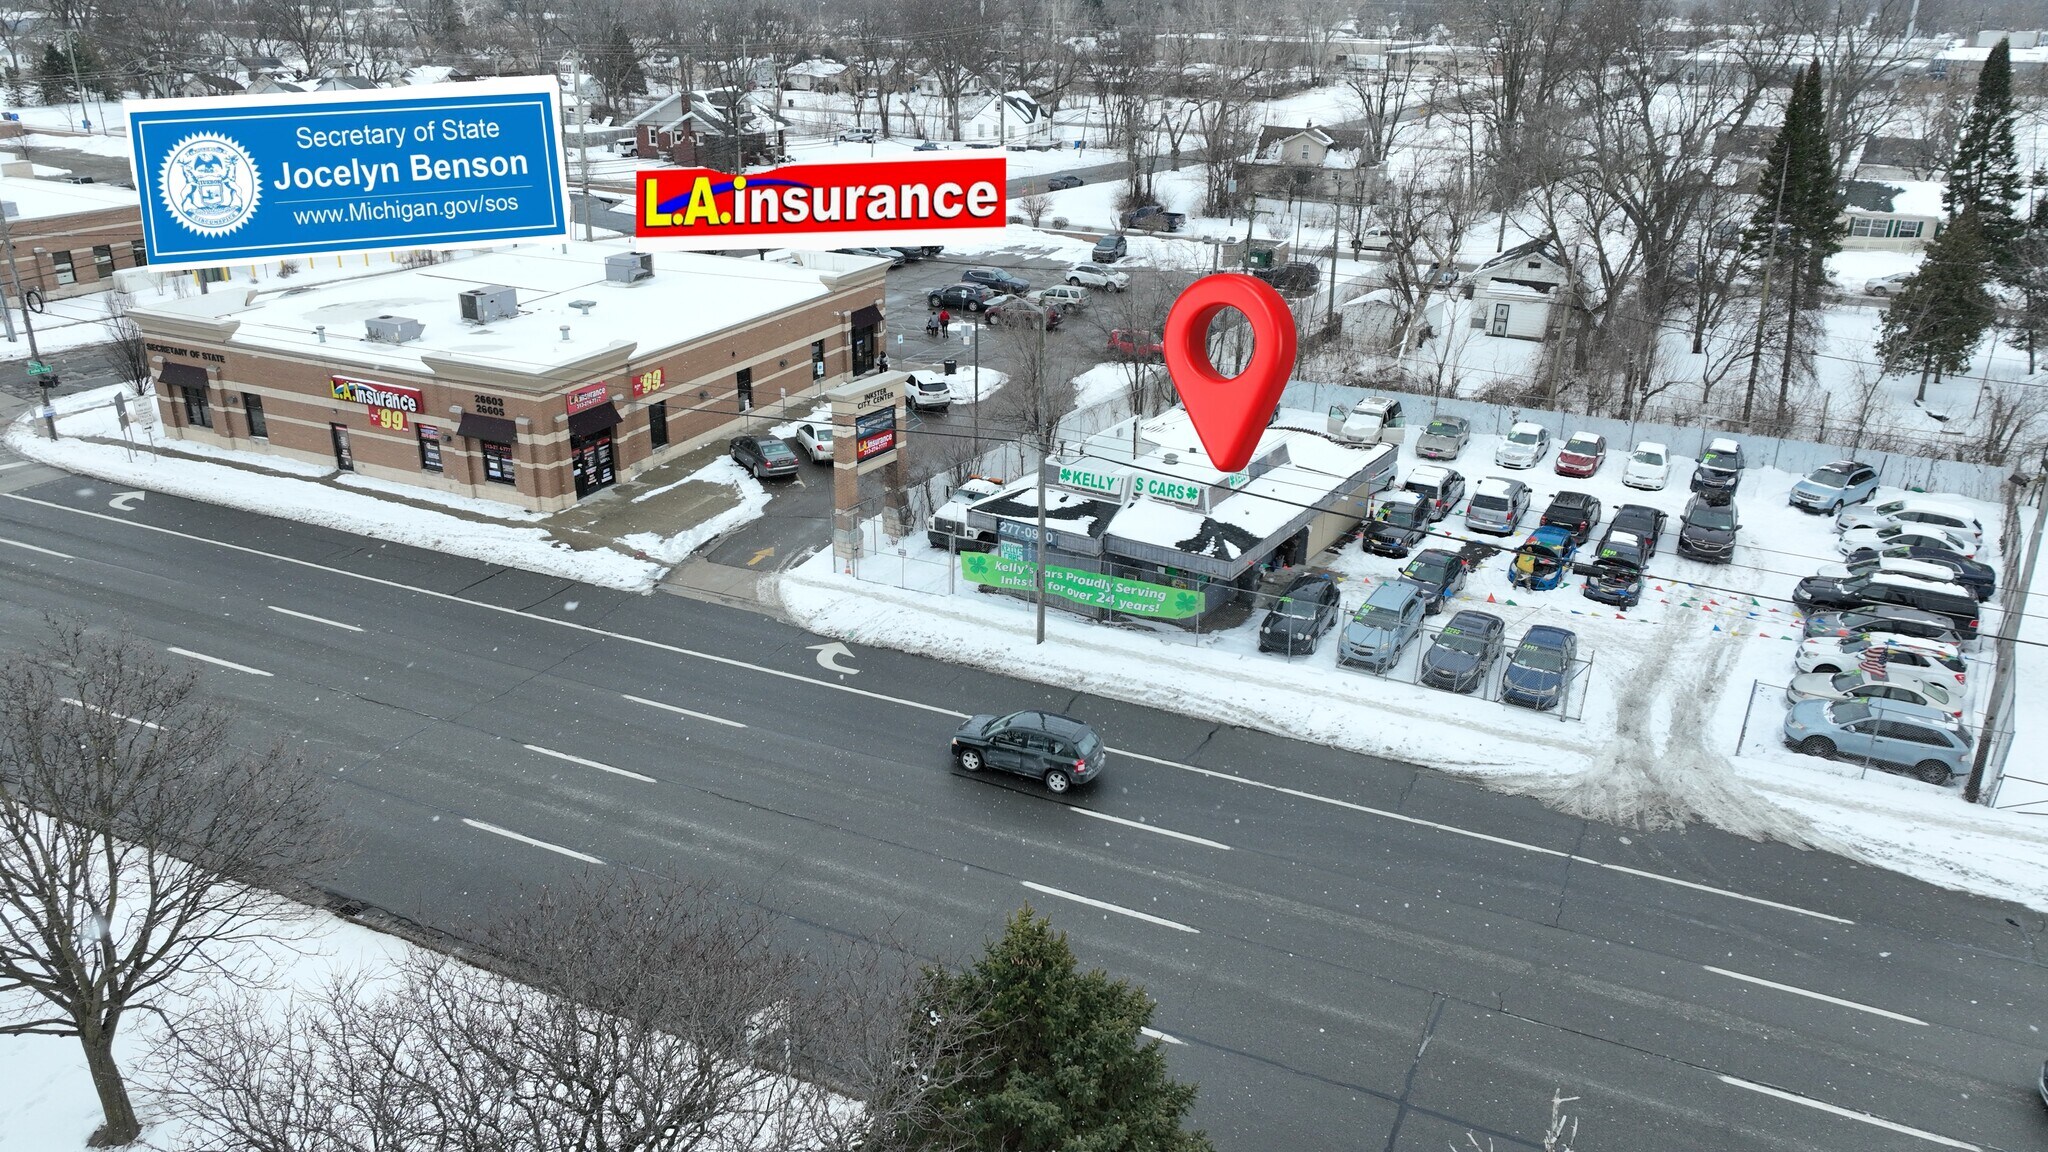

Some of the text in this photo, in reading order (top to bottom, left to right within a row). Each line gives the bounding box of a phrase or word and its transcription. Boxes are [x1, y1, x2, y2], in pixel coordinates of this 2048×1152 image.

[146, 343, 226, 363] SECRETARY OF STATE
[474, 394, 504, 406] 26603
[857, 392, 894, 409] CITY CENTER
[864, 388, 887, 400] INKSTER
[476, 405, 505, 416] 26605
[1149, 480, 1185, 499] CARS
[1000, 521, 1053, 543] 277-090
[995, 561, 1167, 602] Kelly's ars Proudly Serving
[1001, 575, 1161, 613] Inkst for over 24 years!
